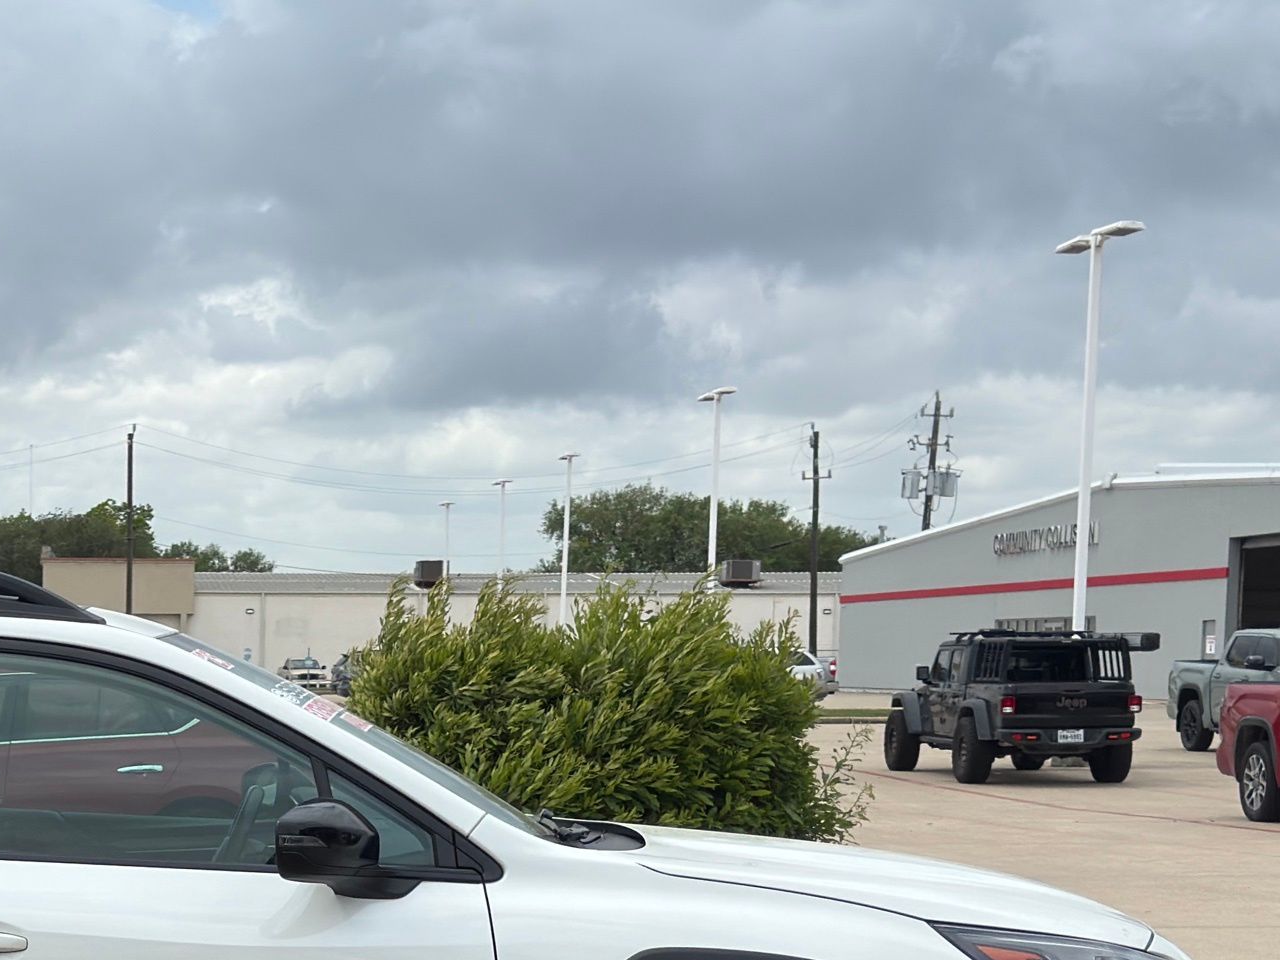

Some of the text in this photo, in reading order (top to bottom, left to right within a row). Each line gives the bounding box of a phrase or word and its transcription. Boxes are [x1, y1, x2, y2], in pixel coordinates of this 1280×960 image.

[993, 522, 1099, 556] COMMUNITY COLLISN
[1056, 697, 1087, 709] Jeep
